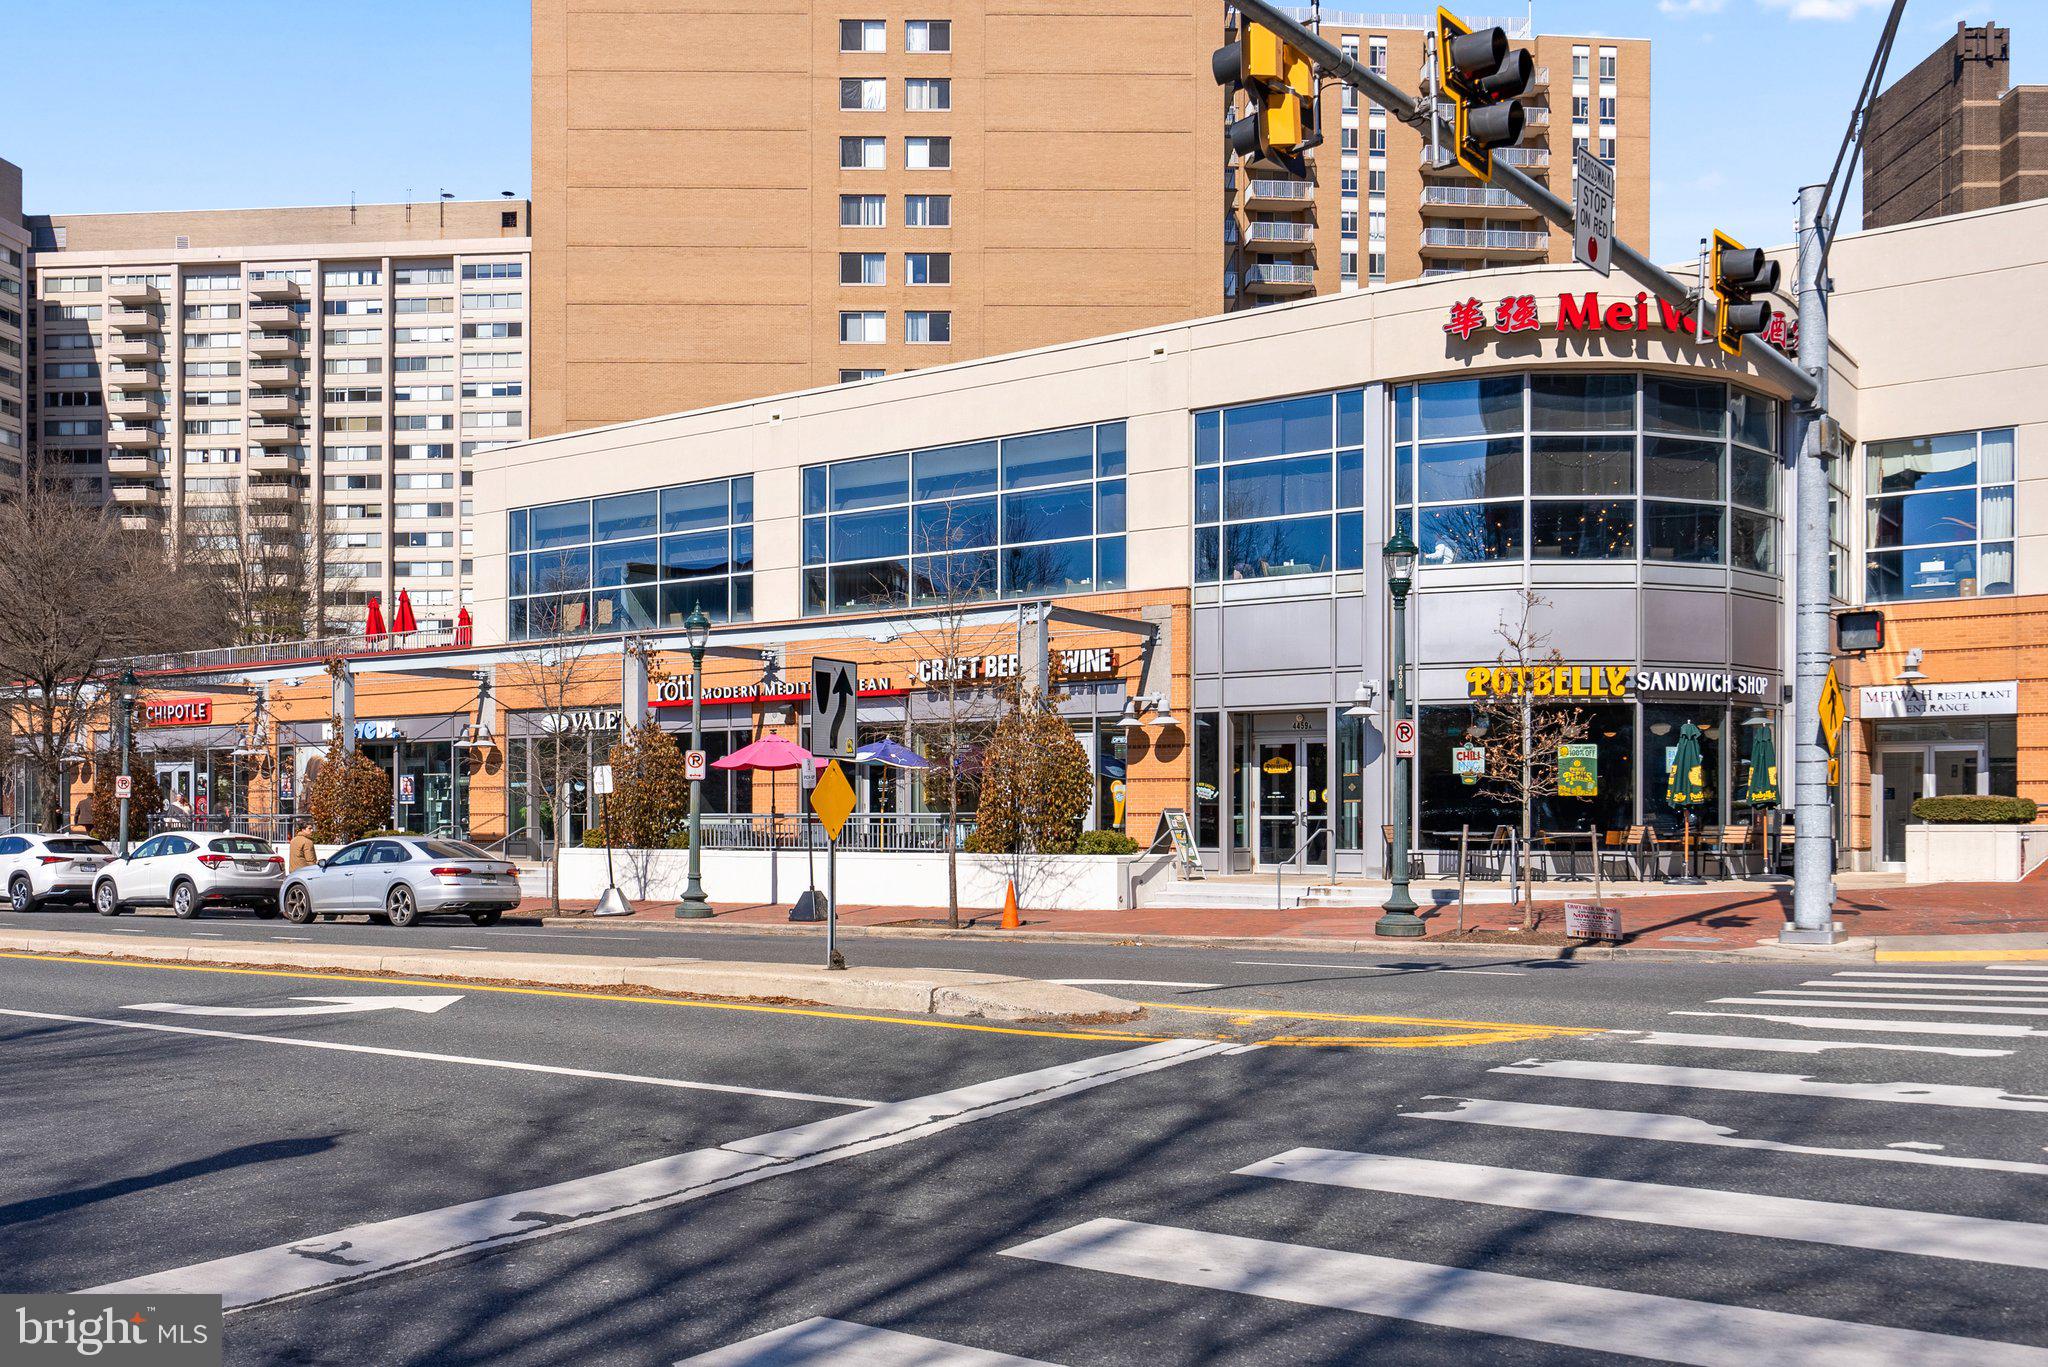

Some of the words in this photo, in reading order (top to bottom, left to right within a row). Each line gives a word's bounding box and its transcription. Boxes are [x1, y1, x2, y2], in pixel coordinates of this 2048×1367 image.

[1580, 155, 1611, 190] CROSSWALK
[1583, 186, 1607, 215] STOP
[1580, 207, 1590, 229] ON
[1593, 217, 1608, 240] RED
[1555, 291, 1648, 332] Mei
[918, 656, 981, 683] CRAFT
[985, 652, 1019, 678] BEE
[1062, 648, 1112, 674] WINE
[701, 684, 758, 700] MODERN
[765, 677, 890, 696] MEDITEAN
[1465, 665, 1631, 698] POTBELLY
[1637, 671, 1732, 693] SANDWICH
[1737, 676, 1768, 695] SHOP
[1906, 702, 1970, 713] ENTRANCE
[1937, 690, 2012, 700] RESTAURANT
[146, 703, 206, 720] CHIPOTLE
[1456, 751, 1481, 761] CHILI
[1592, 914, 1614, 922] OPEN
